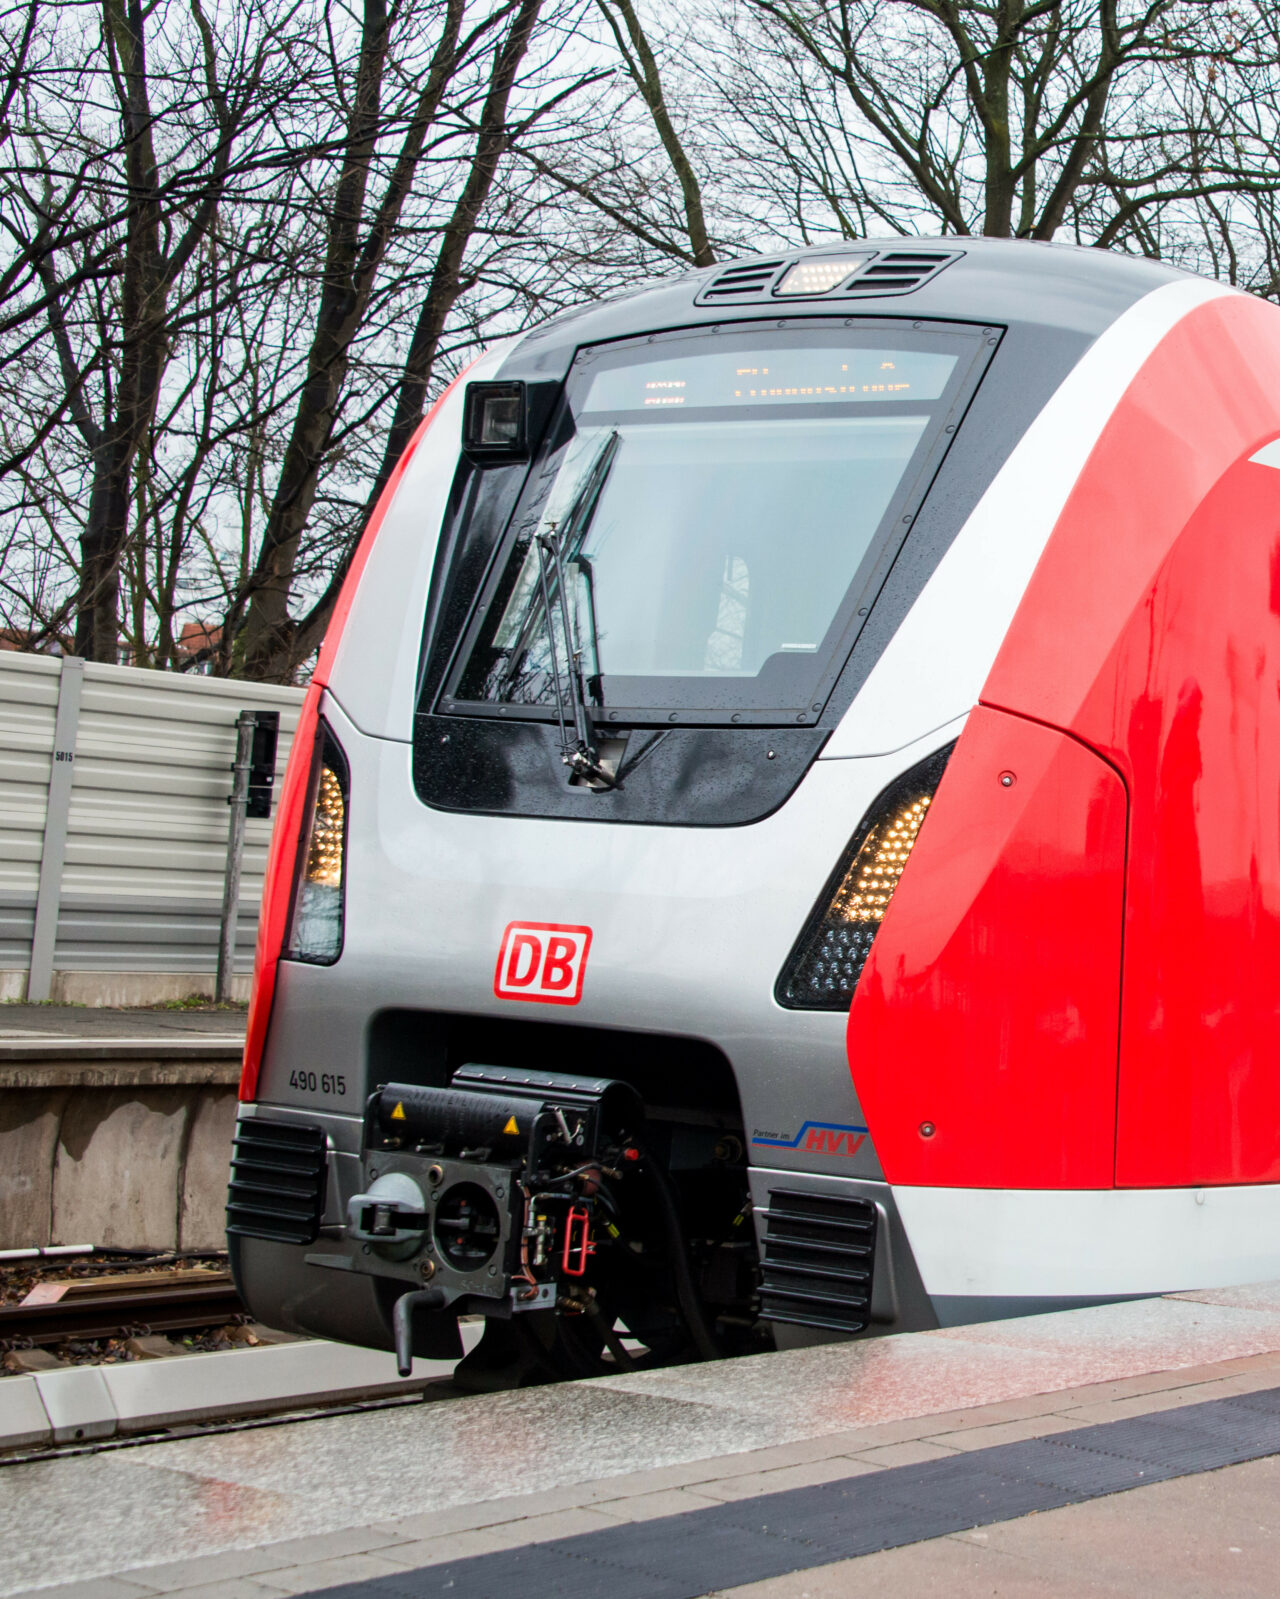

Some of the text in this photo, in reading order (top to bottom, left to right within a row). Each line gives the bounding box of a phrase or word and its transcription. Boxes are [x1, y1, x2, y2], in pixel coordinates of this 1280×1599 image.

[505, 934, 577, 991] DB
[289, 1070, 346, 1096] 490 615
[753, 1128, 790, 1140] Partner im
[805, 1129, 866, 1155] HVV
